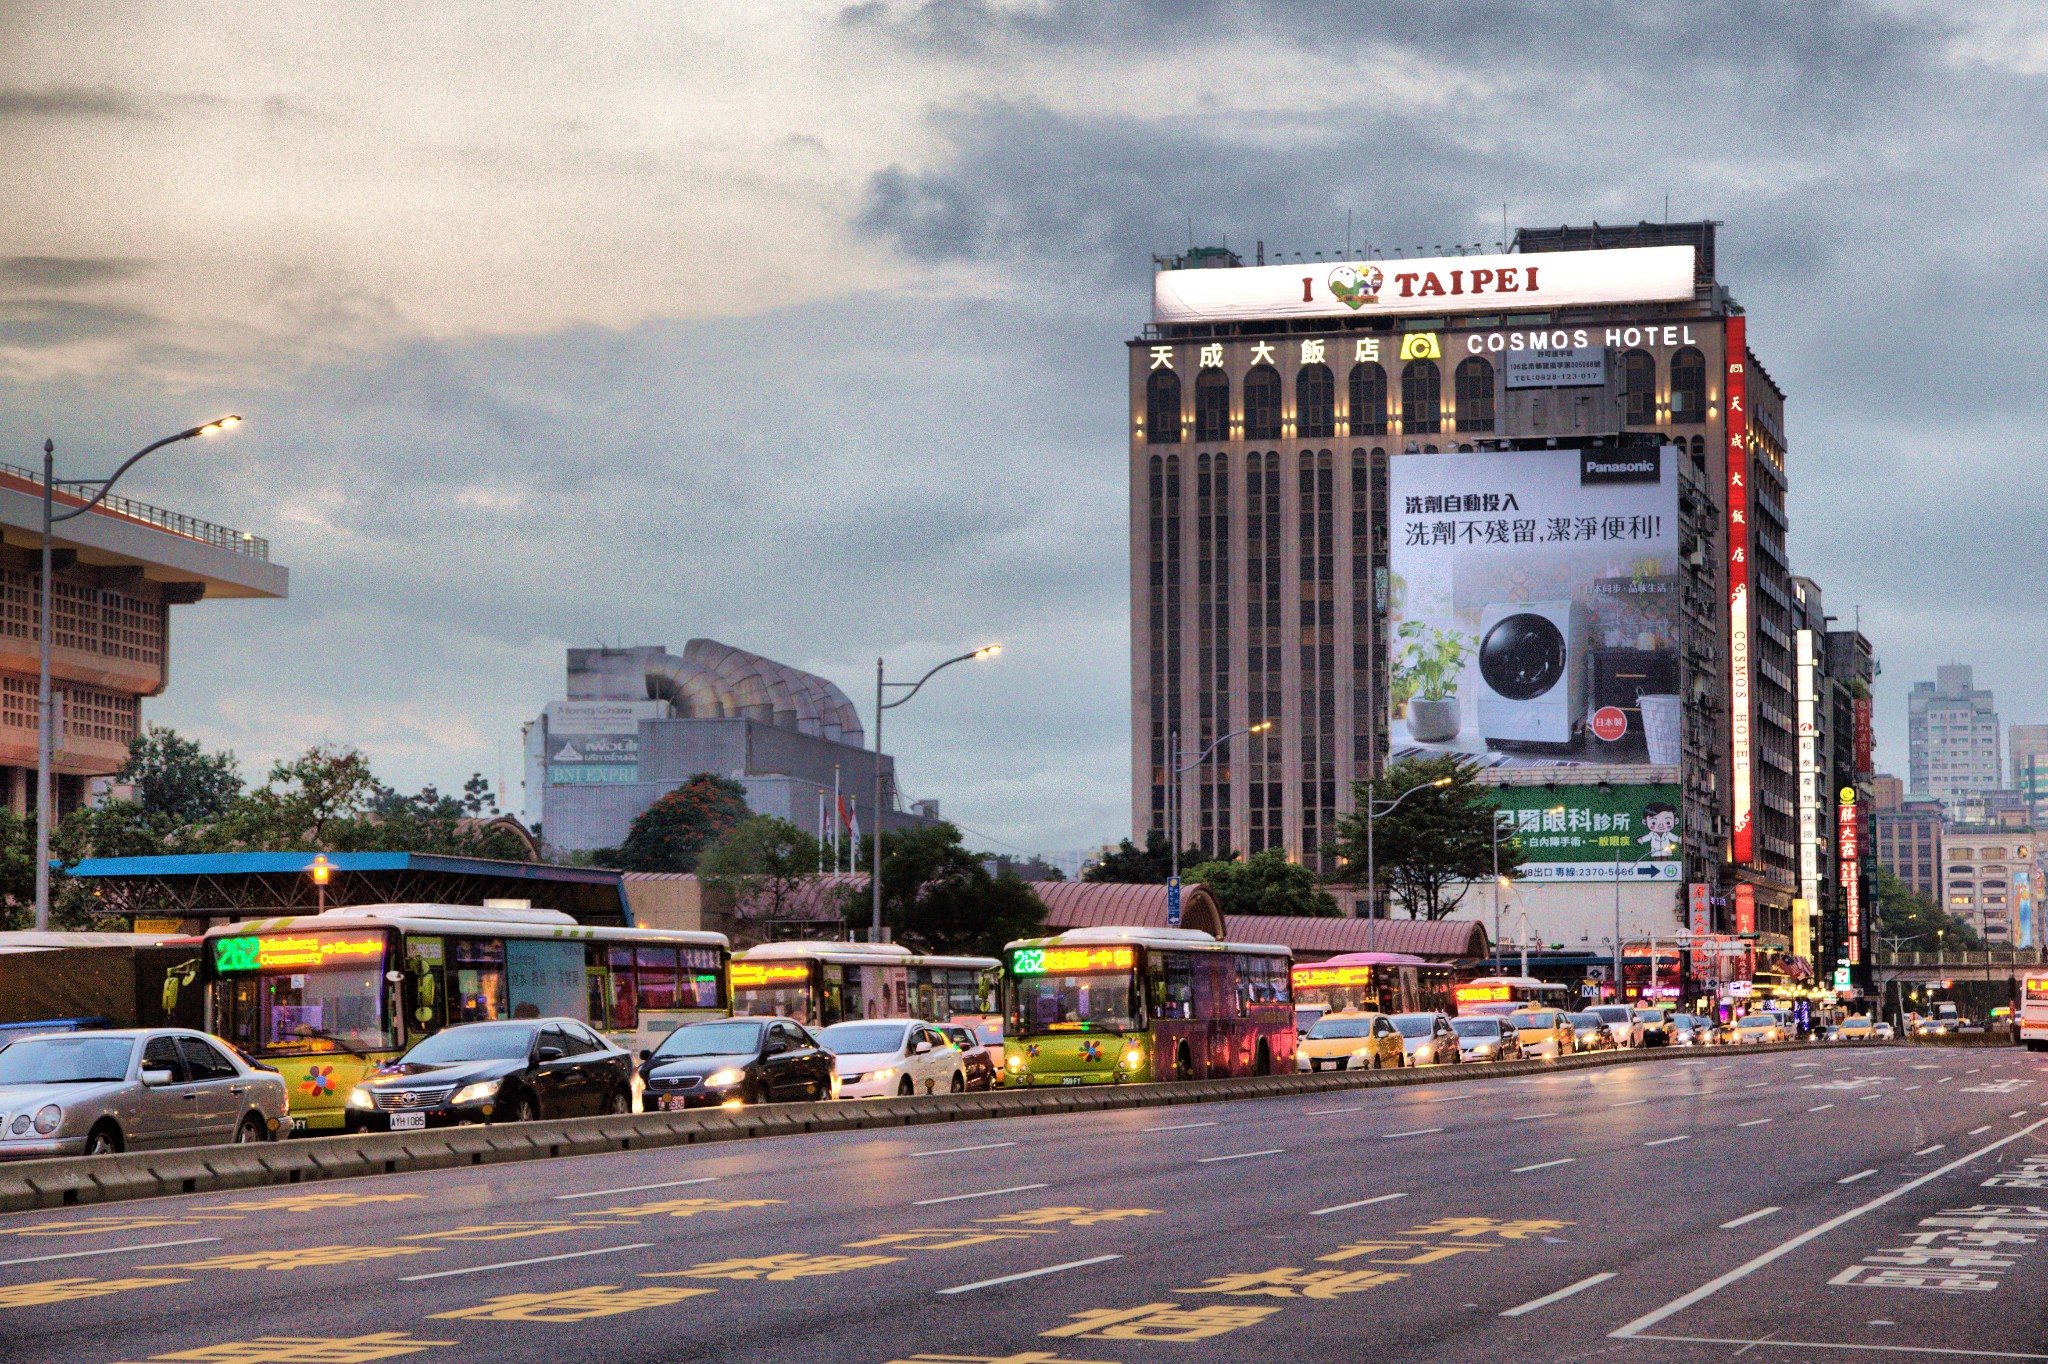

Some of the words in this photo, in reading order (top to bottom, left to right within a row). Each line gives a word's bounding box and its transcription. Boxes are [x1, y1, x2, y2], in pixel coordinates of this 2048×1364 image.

[1302, 277, 1313, 302] I
[1395, 267, 1539, 297] TAIPEI
[1150, 337, 1380, 370] 天成大飯店
[1467, 329, 1588, 354] COSMOS
[1605, 325, 1696, 348] HOTEL
[1586, 459, 1655, 474] Panasonic
[1730, 395, 1745, 563] 天成大飯店
[1405, 493, 1520, 514] 洗劑自動投入
[1734, 631, 1747, 699] COSMOS
[1596, 717, 1623, 727] 日本製
[1736, 714, 1748, 769] HOTEL
[216, 936, 261, 972] 262
[1014, 949, 1046, 973] 262
